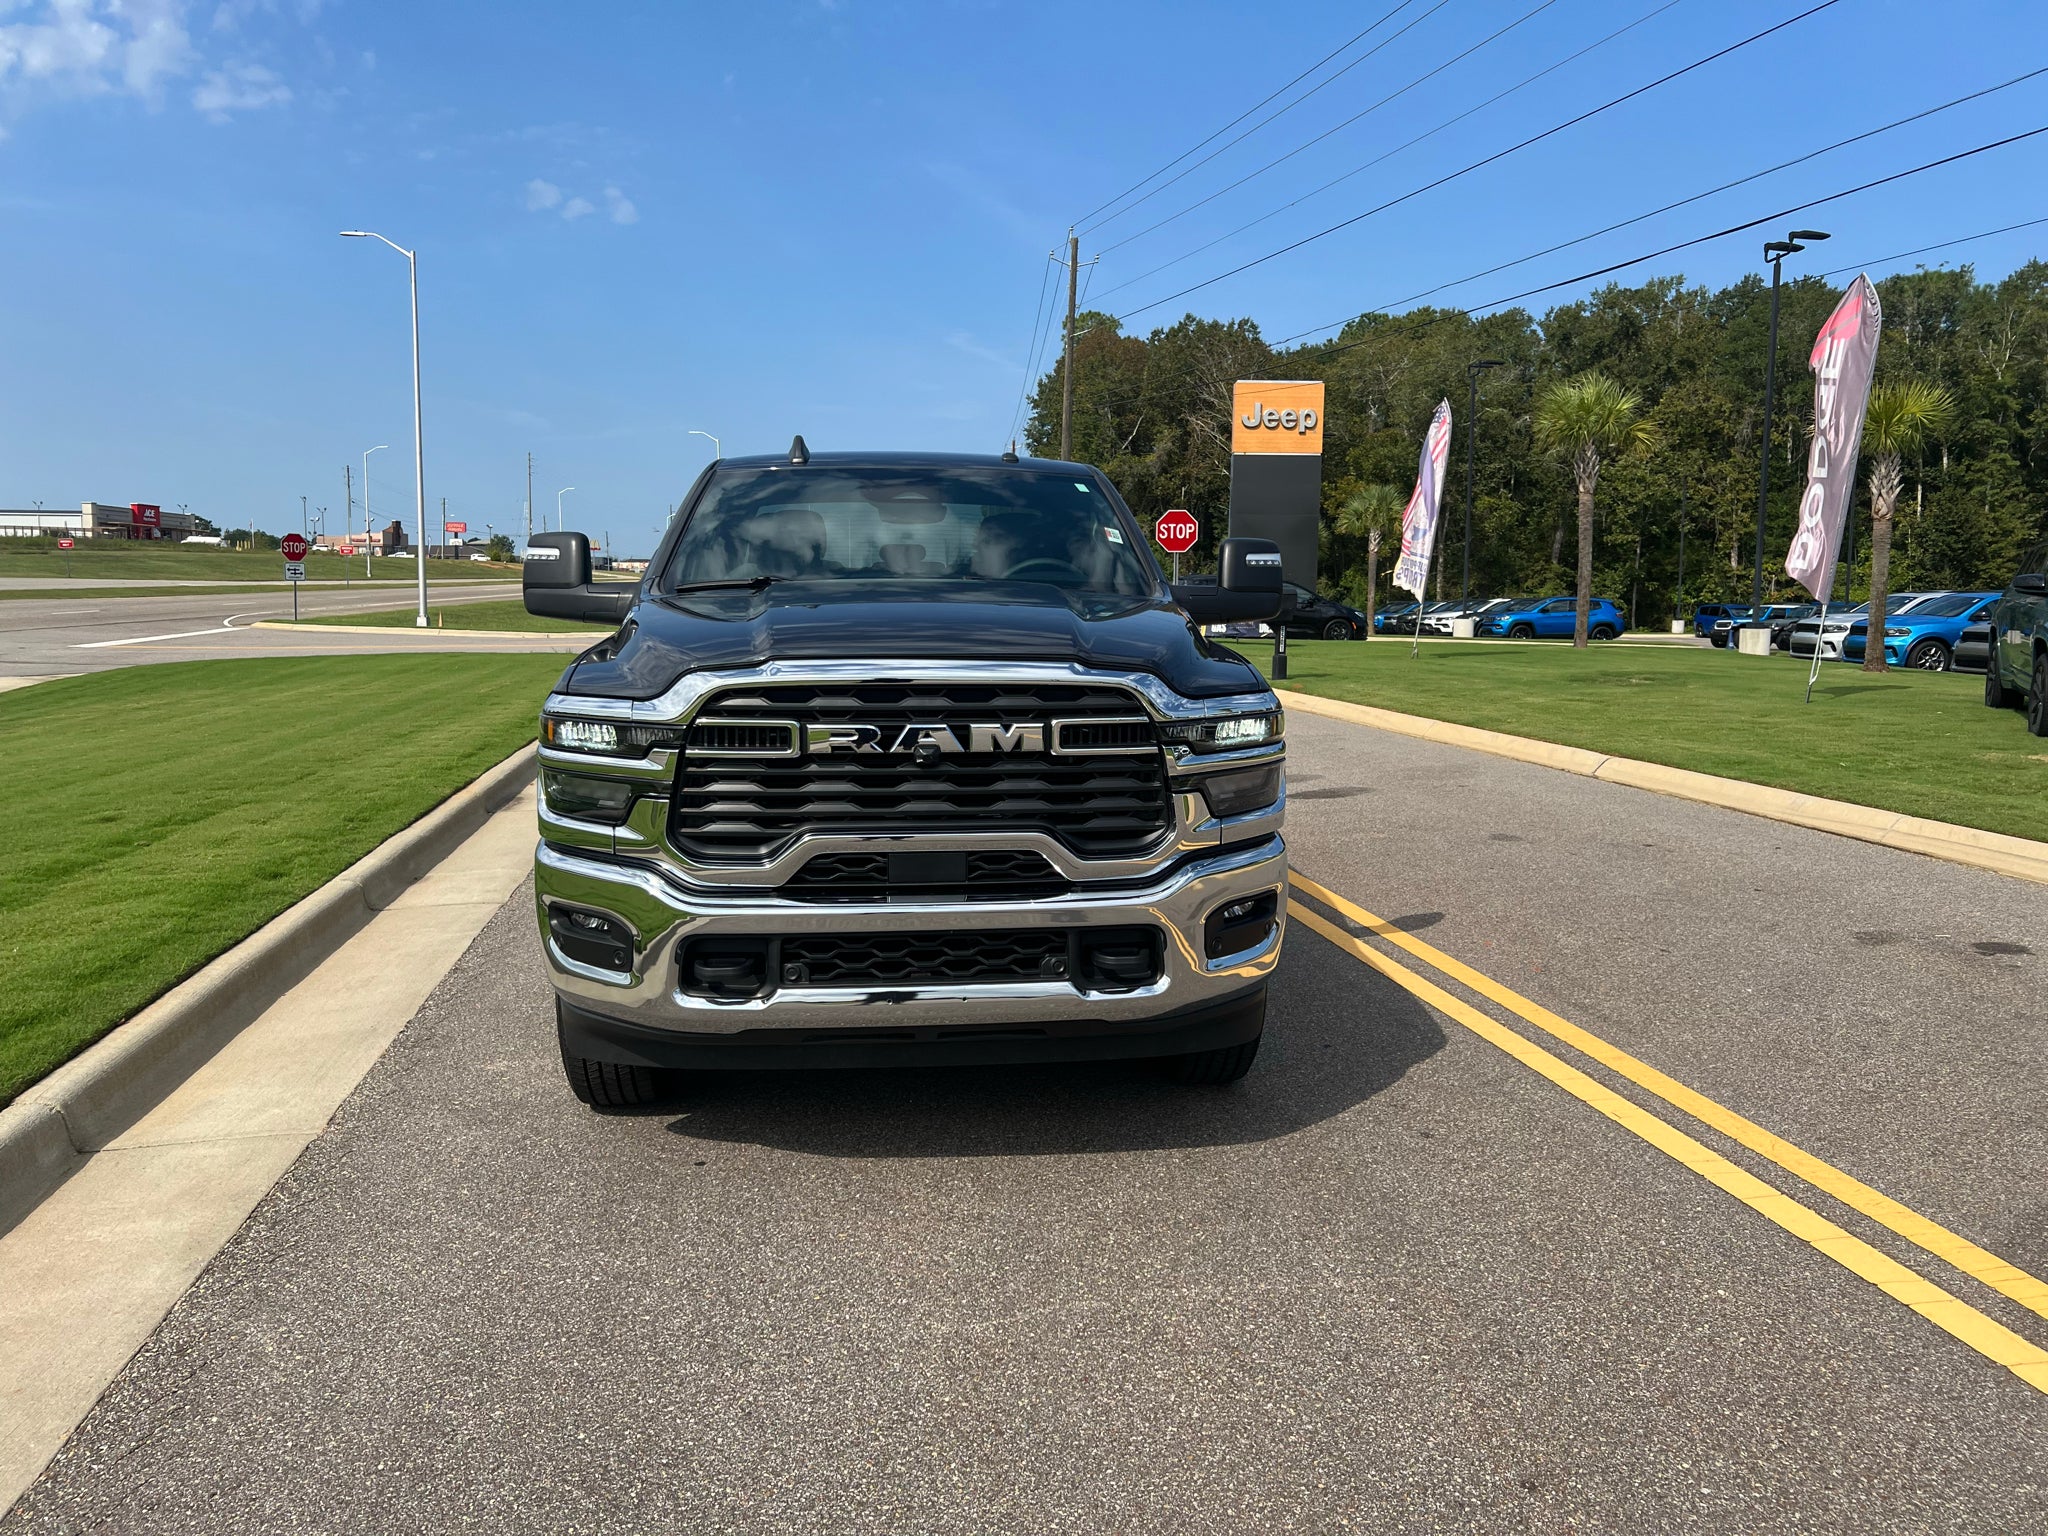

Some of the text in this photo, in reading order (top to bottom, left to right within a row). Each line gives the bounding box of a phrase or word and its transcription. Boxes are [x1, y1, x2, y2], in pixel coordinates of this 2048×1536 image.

[1242, 402, 1317, 433] Jeep
[1790, 336, 1847, 571] DODGE
[1159, 523, 1195, 539] STOP
[283, 541, 306, 553] STOP
[806, 723, 1045, 753] RAM
